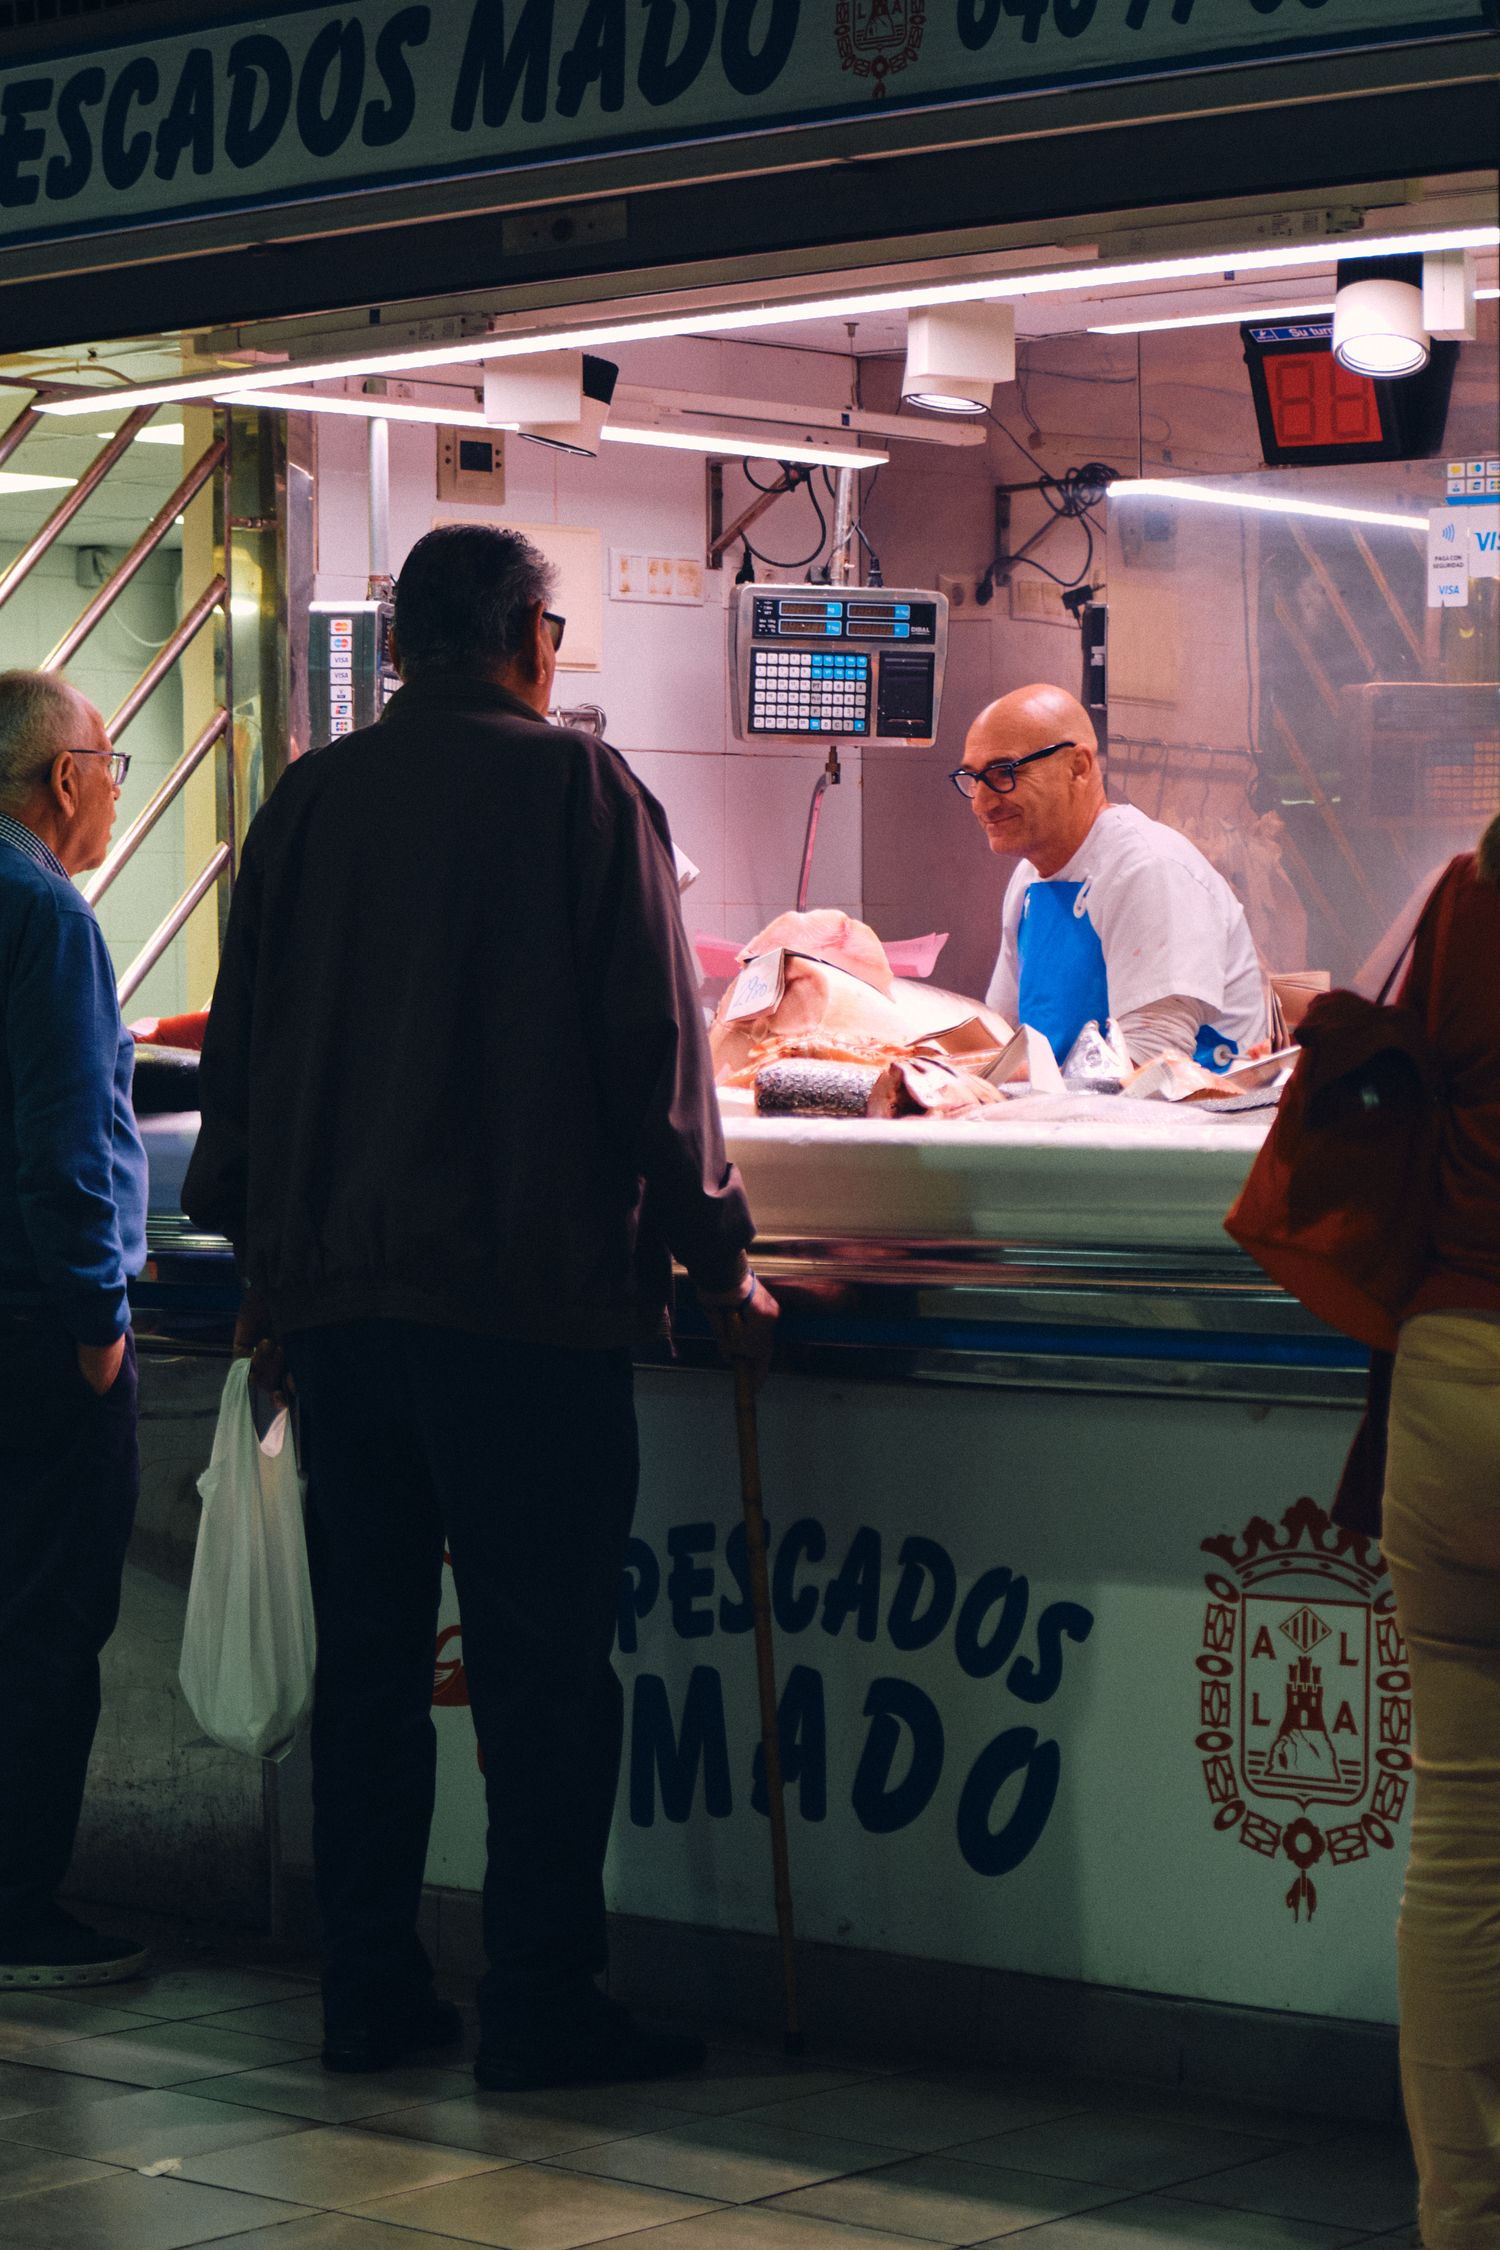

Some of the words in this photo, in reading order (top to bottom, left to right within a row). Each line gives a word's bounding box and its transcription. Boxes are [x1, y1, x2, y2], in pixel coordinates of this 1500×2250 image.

[451, 0, 797, 131] MADO
[1288, 327, 1308, 337] Su
[1309, 326, 1334, 336] turn
[1474, 531, 1500, 552] VI
[1439, 585, 1460, 595] VISA
[617, 1517, 1095, 1704] PESCADOS
[1251, 1625, 1277, 1660] A
[1339, 1632, 1360, 1667] L
[1251, 1692, 1272, 1727] L
[1332, 1700, 1359, 1736] A
[630, 1665, 1061, 1877] MADO
